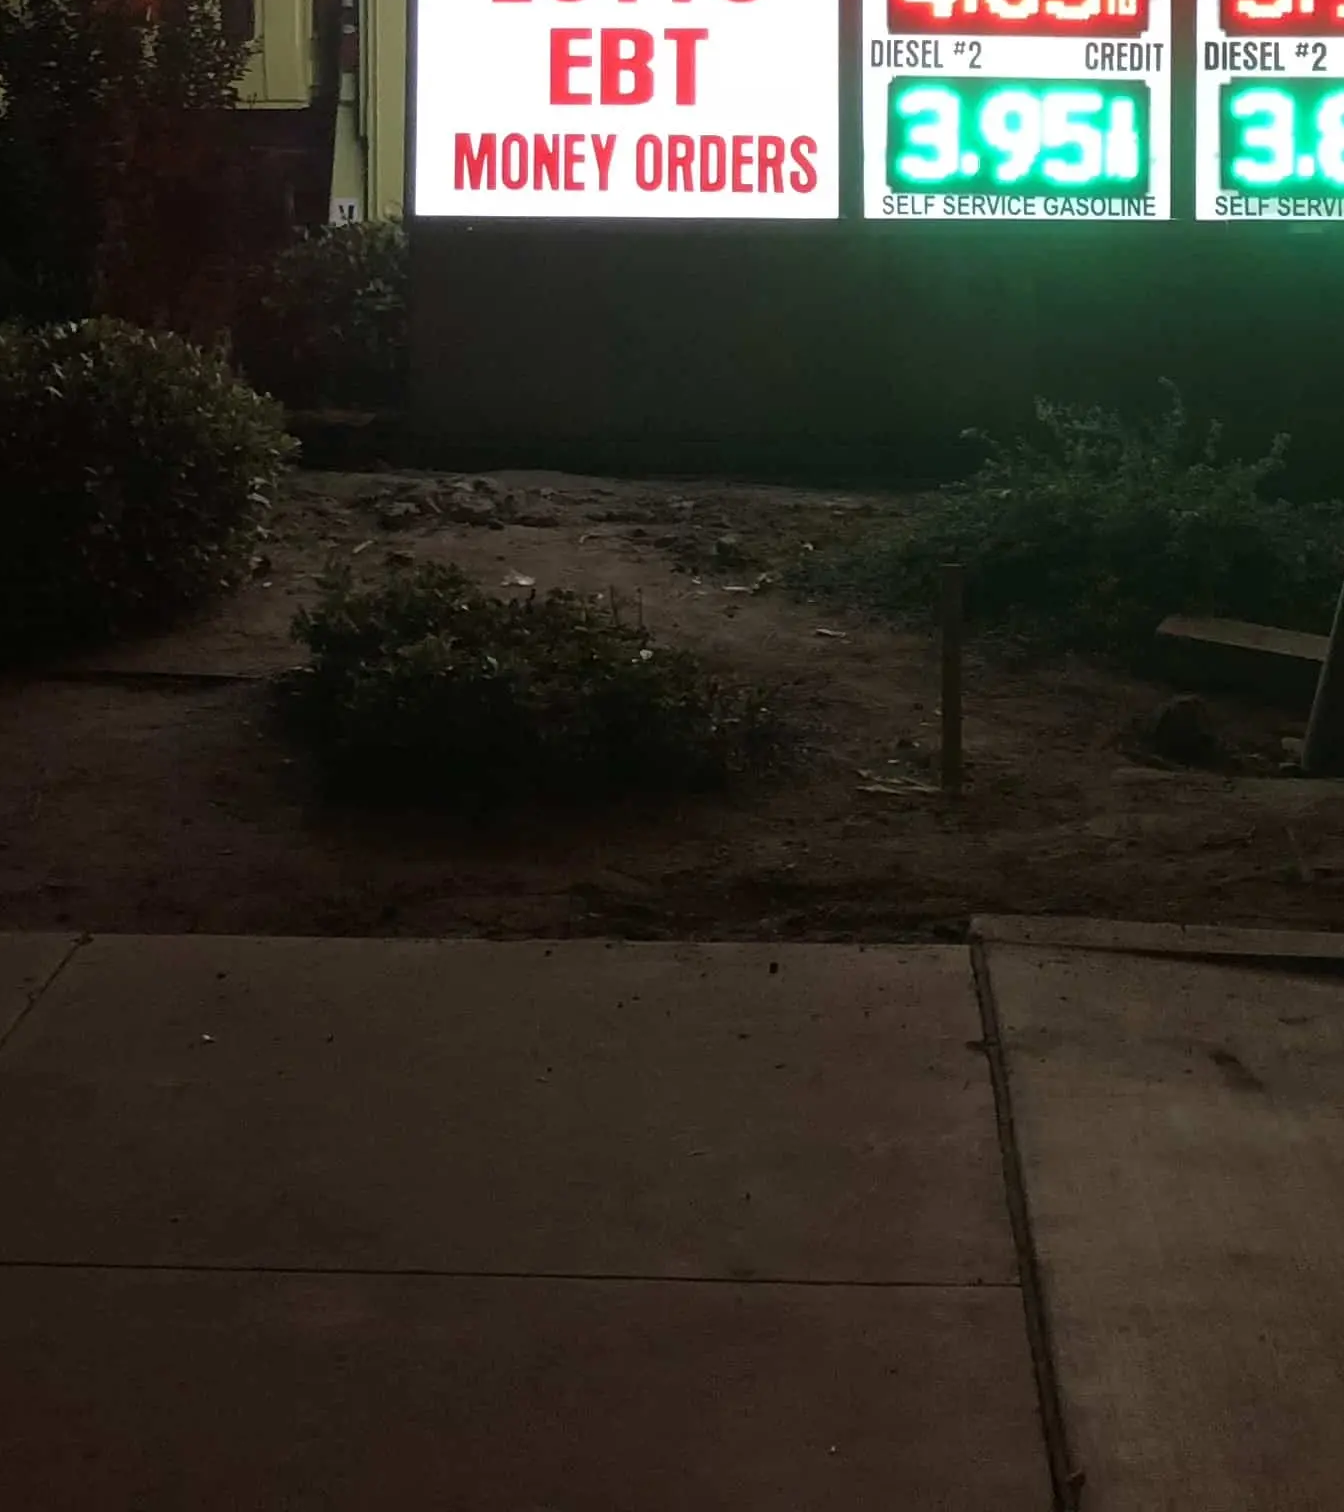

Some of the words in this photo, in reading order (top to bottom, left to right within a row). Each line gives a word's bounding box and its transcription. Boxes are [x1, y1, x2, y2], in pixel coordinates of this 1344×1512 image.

[549, 28, 709, 106] EBT
[870, 40, 944, 68] DIESEL
[1085, 42, 1164, 72] CREDIT
[1204, 41, 1285, 71] DIESEL
[454, 133, 617, 192] MONEY
[635, 134, 818, 194] ORDERS
[882, 195, 935, 216] SELF
[942, 195, 1037, 216] SERVICE
[1043, 196, 1157, 217] GASOLINE
[1214, 195, 1270, 216] SELF
